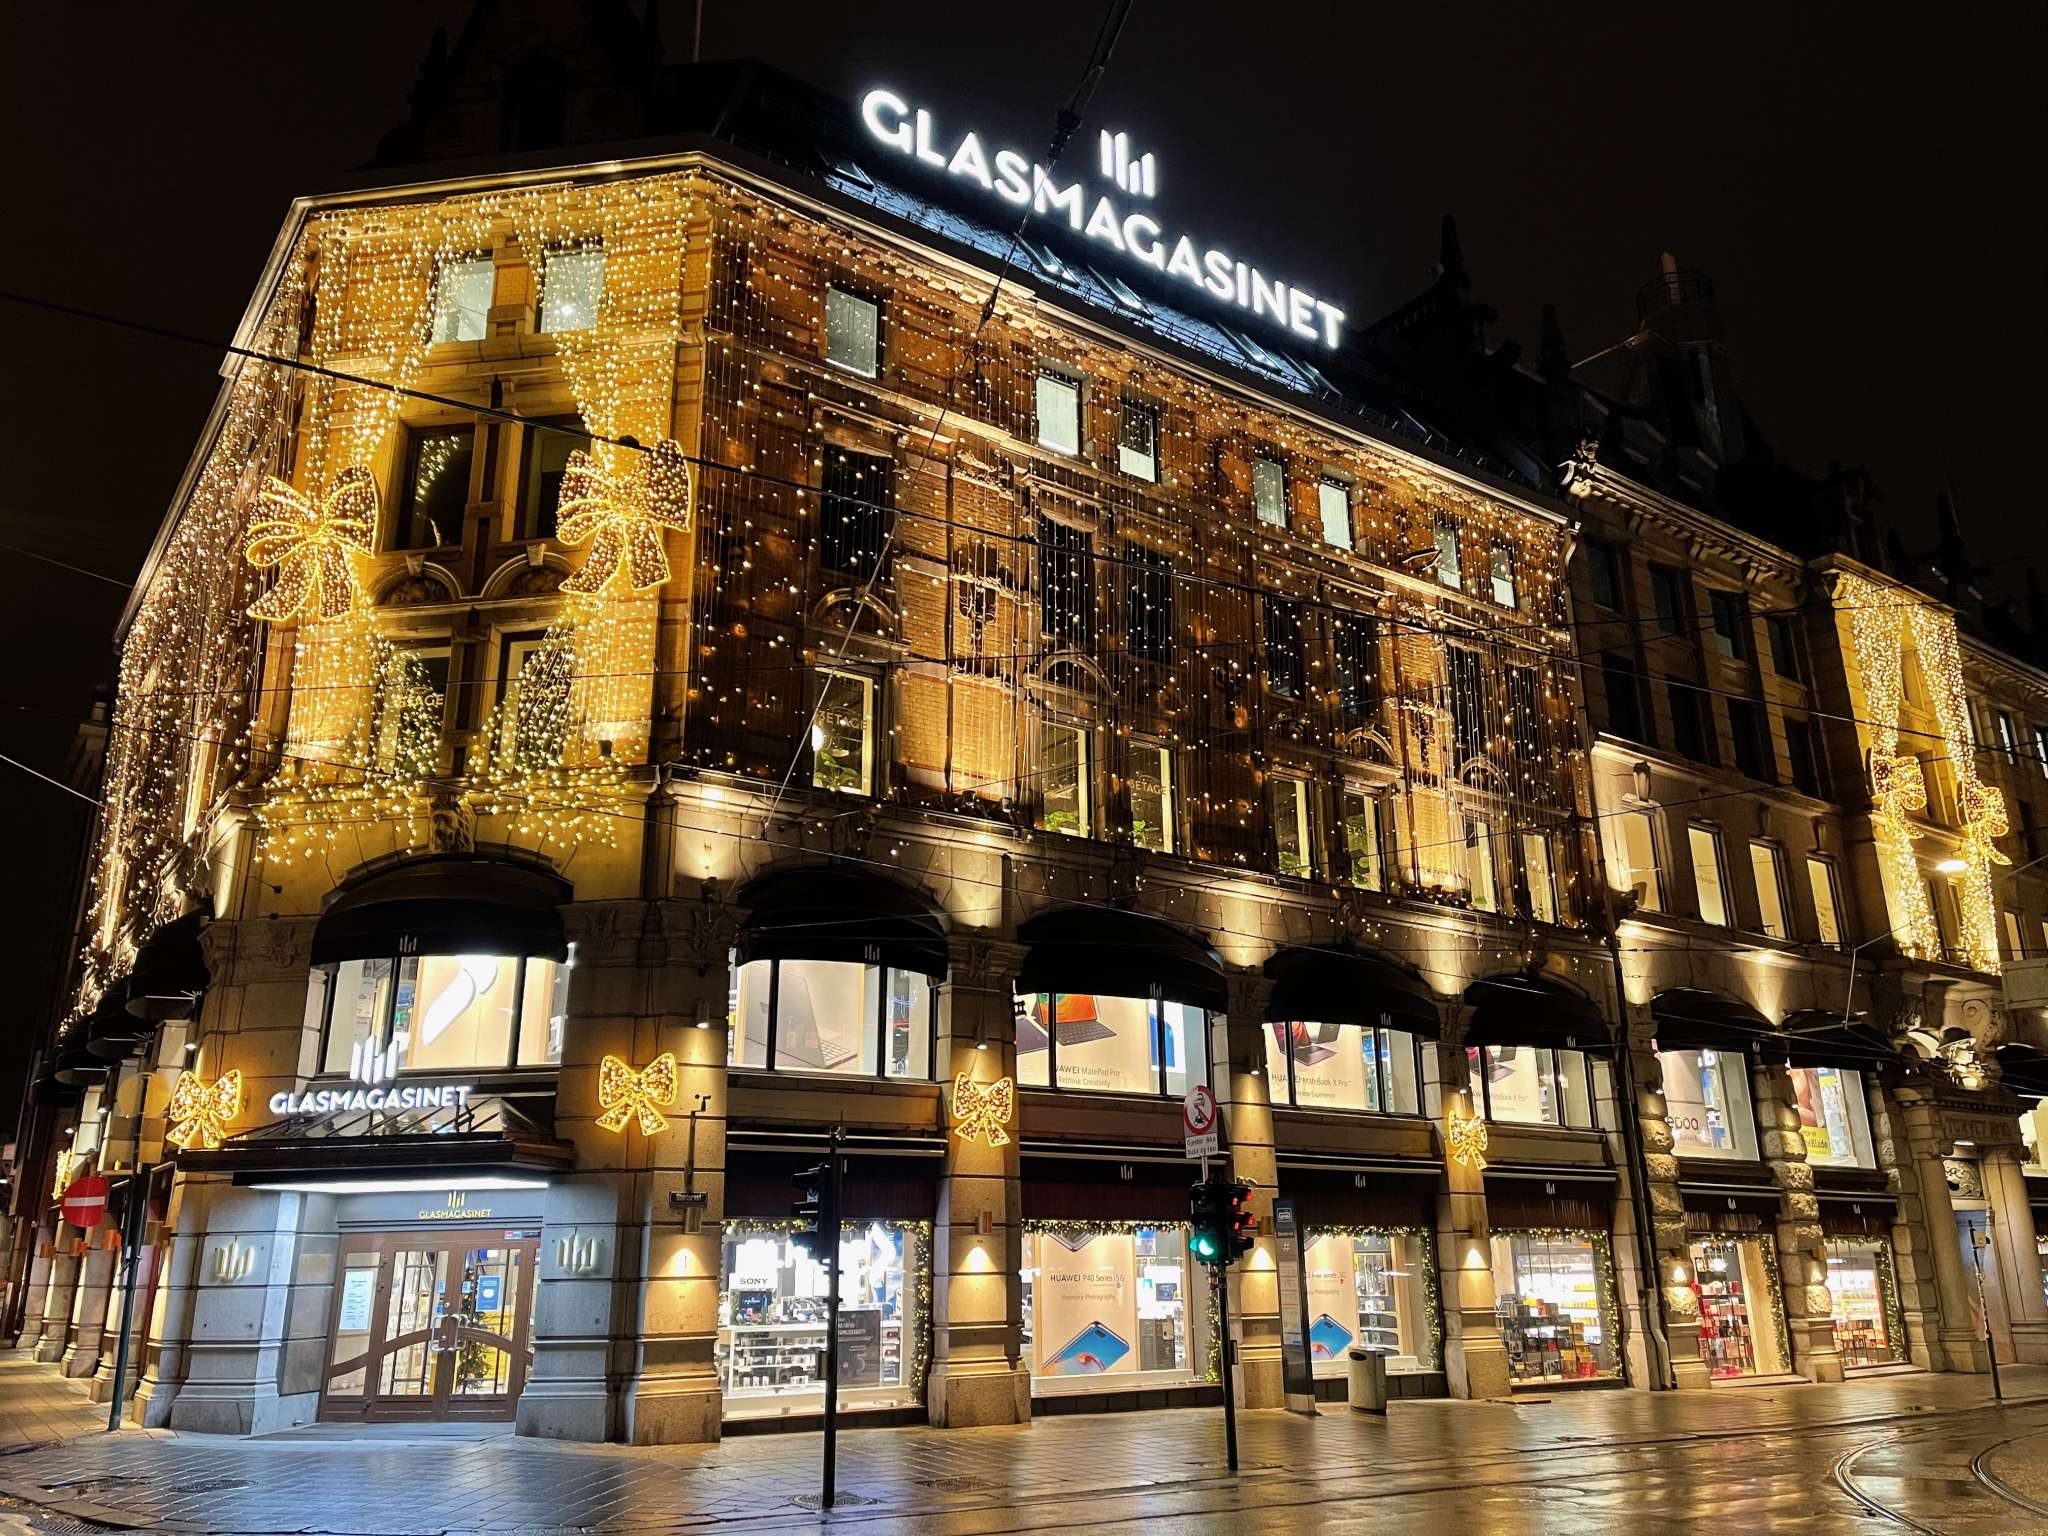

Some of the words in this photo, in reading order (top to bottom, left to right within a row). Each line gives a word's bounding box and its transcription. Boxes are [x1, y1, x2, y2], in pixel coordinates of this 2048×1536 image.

[862, 90, 1344, 348] GLASMAGASINET
[1271, 1073, 1301, 1083] HUAEI
[269, 1085, 471, 1115] GLASMAGASINET
[418, 1208, 492, 1220] GLASMAGASINET
[1050, 1274, 1081, 1283] HUAWEI
